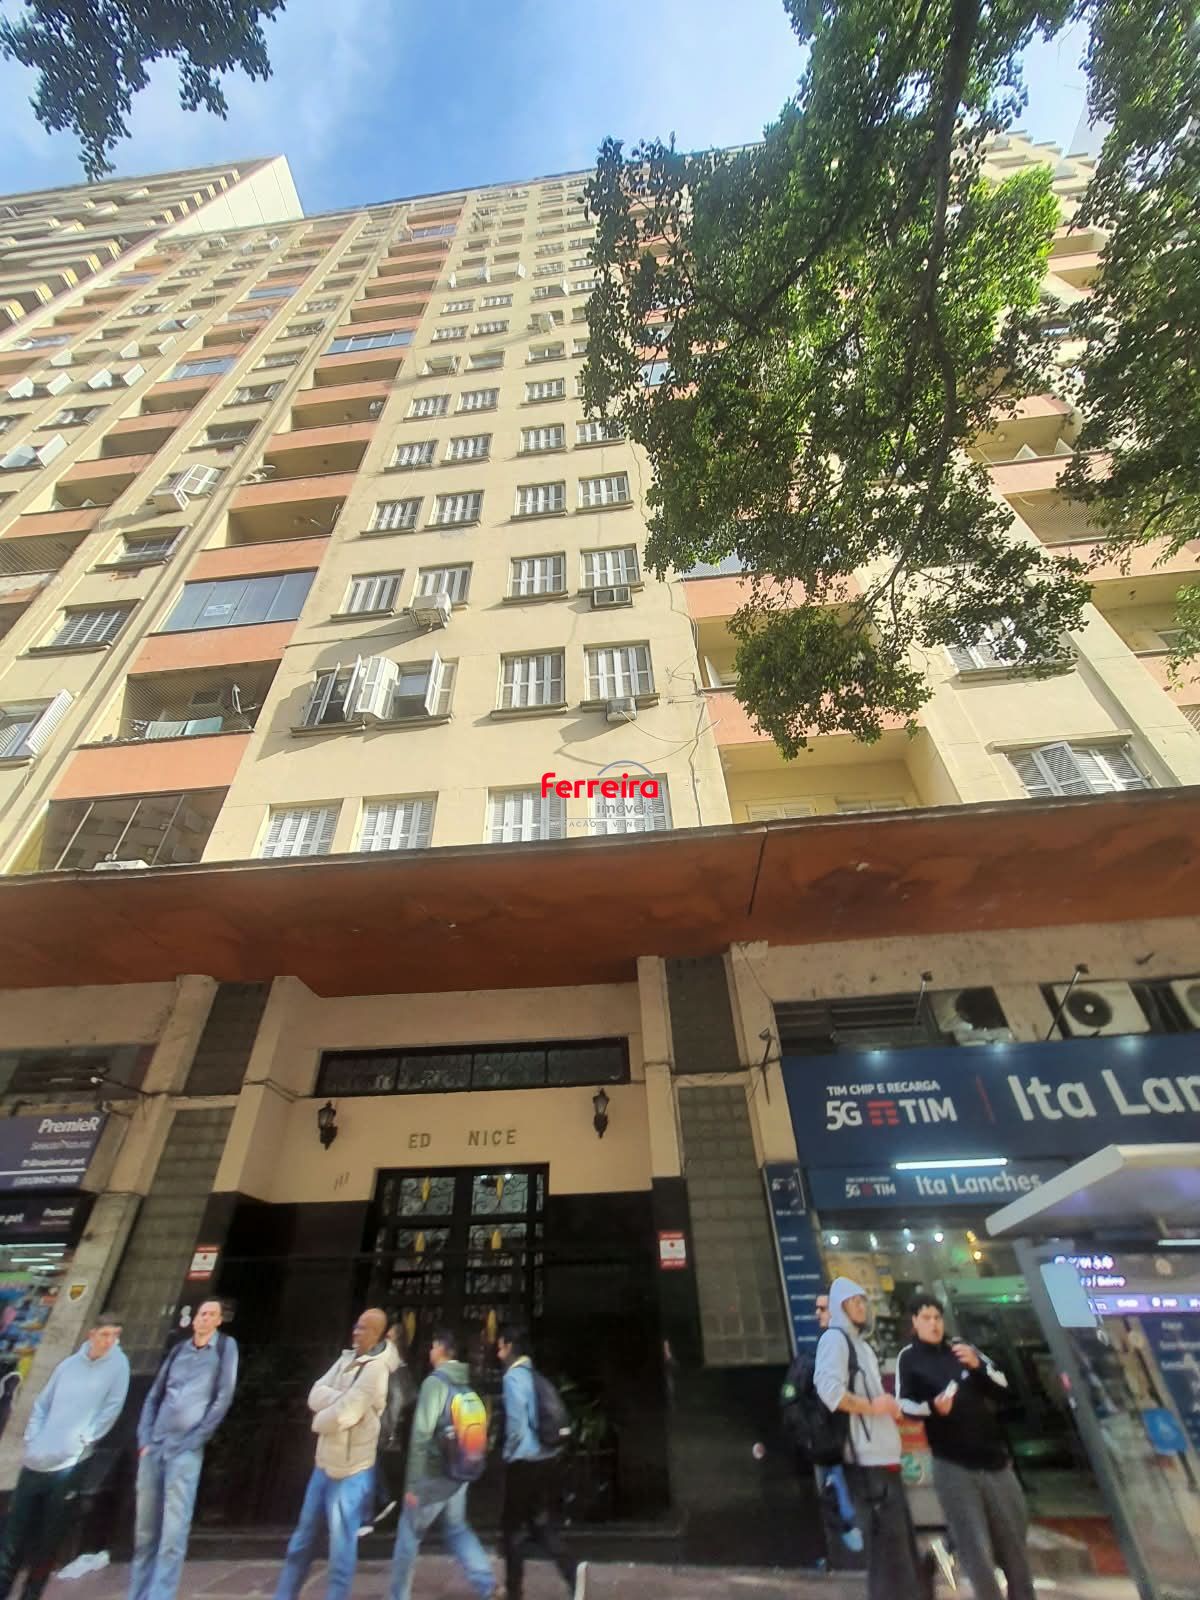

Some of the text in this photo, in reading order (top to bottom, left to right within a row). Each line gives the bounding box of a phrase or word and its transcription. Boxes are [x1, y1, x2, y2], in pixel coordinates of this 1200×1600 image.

[826, 1080, 941, 1096] TIM CHIP E RECARGA
[1008, 1075, 1098, 1121] Ita
[826, 1097, 958, 1131] 5G TIM
[408, 1129, 517, 1149] ED NICE
[845, 1183, 897, 1198] 5G TIM
[915, 1171, 1043, 1195] Ita Lanches
